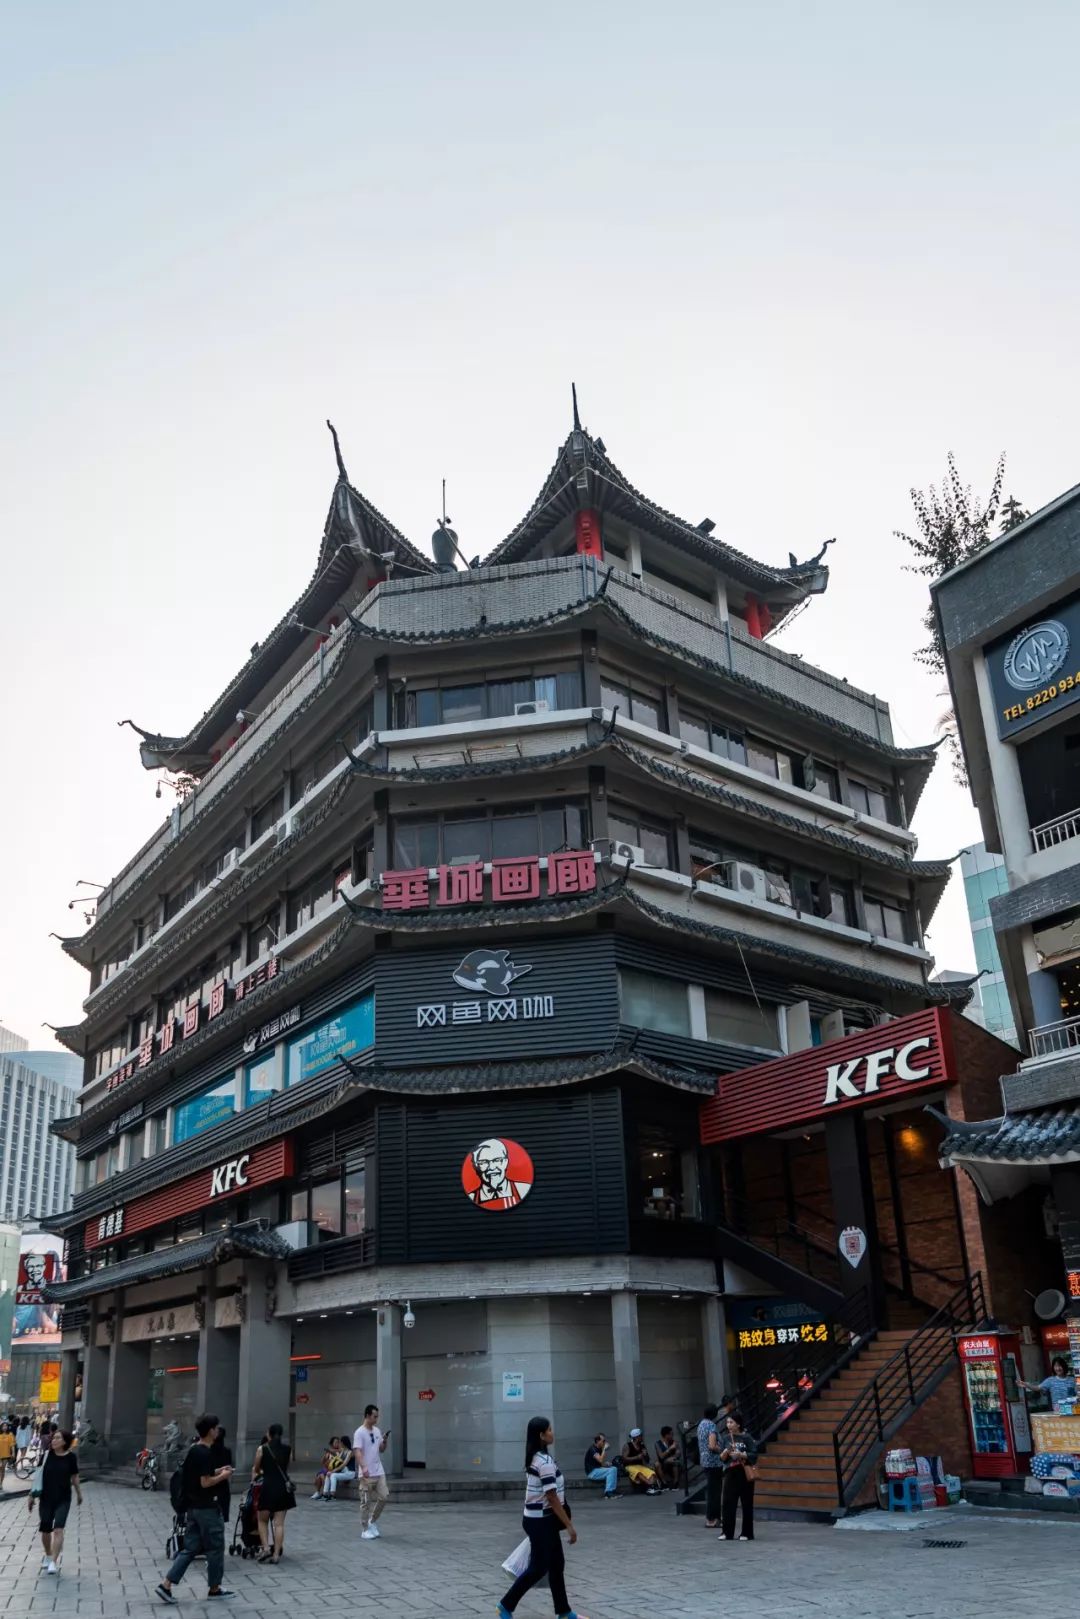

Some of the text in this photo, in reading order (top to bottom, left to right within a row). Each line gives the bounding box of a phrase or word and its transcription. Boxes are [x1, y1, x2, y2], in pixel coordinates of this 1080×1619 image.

[1003, 704, 1026, 721] TEL
[1026, 686, 1058, 710] 8220
[417, 995, 554, 1028] 网鱼网咖
[822, 1036, 931, 1106] KFC
[209, 1154, 250, 1198] KFC
[98, 1208, 123, 1241] 肯德基
